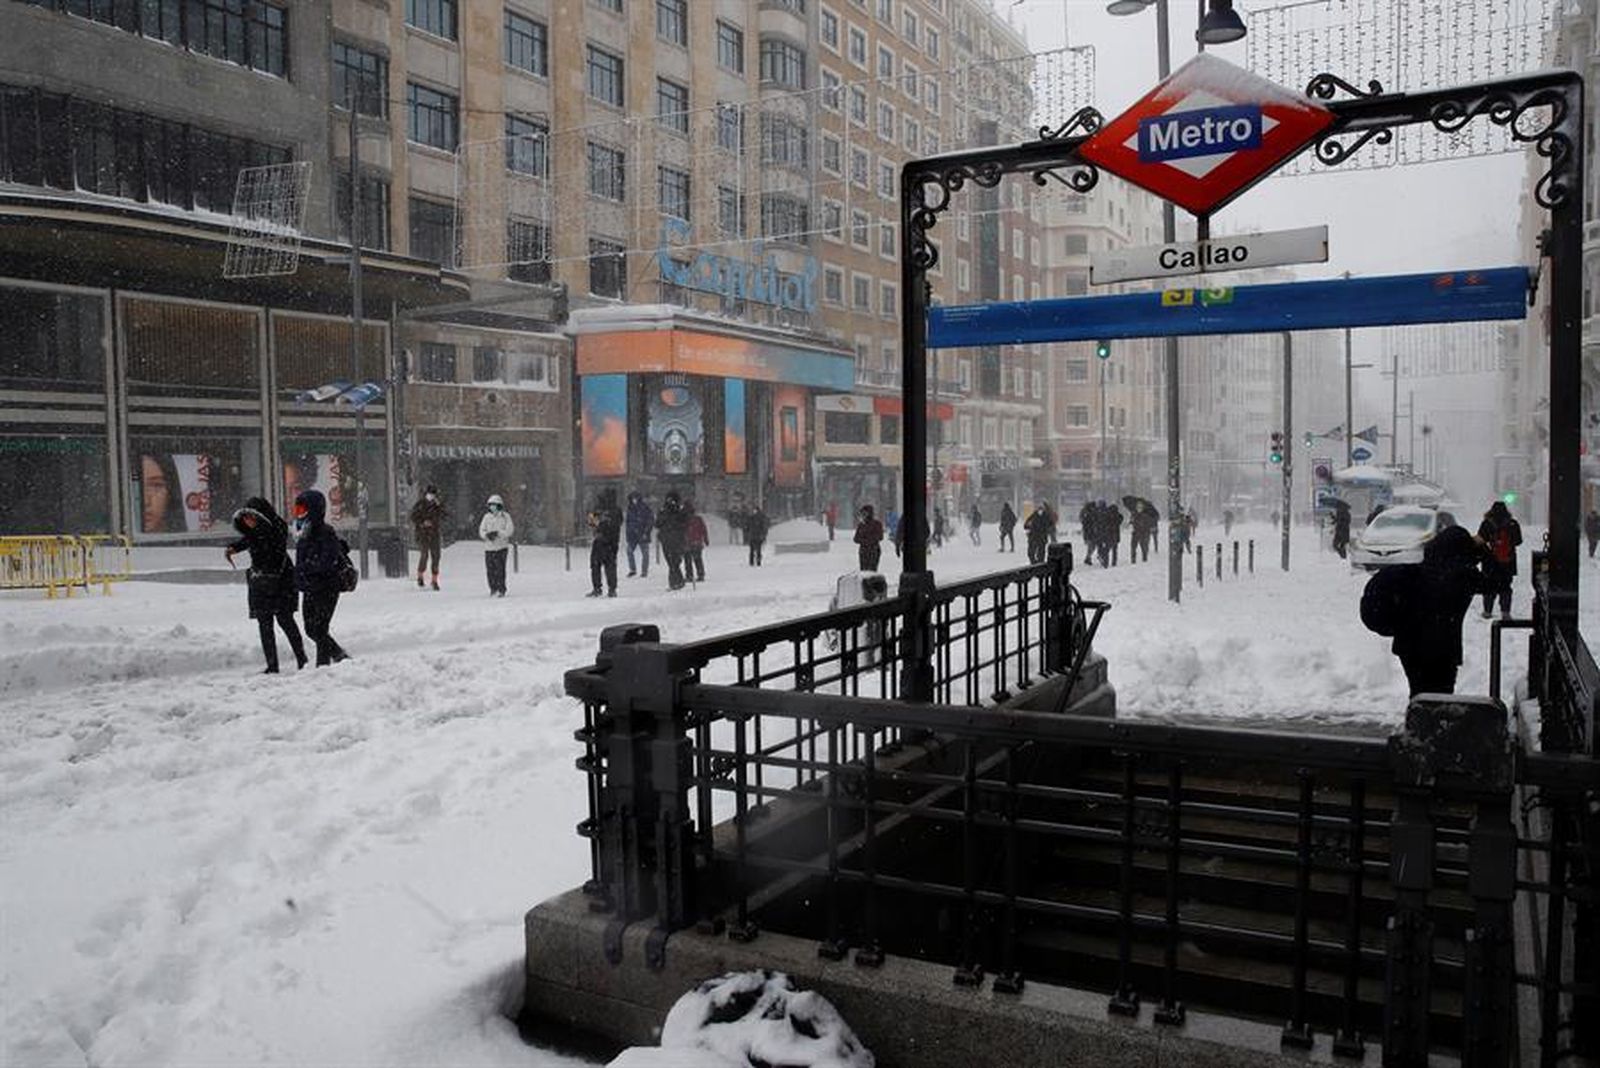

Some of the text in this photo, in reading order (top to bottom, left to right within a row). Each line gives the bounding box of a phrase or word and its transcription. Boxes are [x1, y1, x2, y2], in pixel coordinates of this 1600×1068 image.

[1149, 117, 1252, 152] Metro
[657, 217, 818, 313] Capitol
[1159, 245, 1248, 269] Callao
